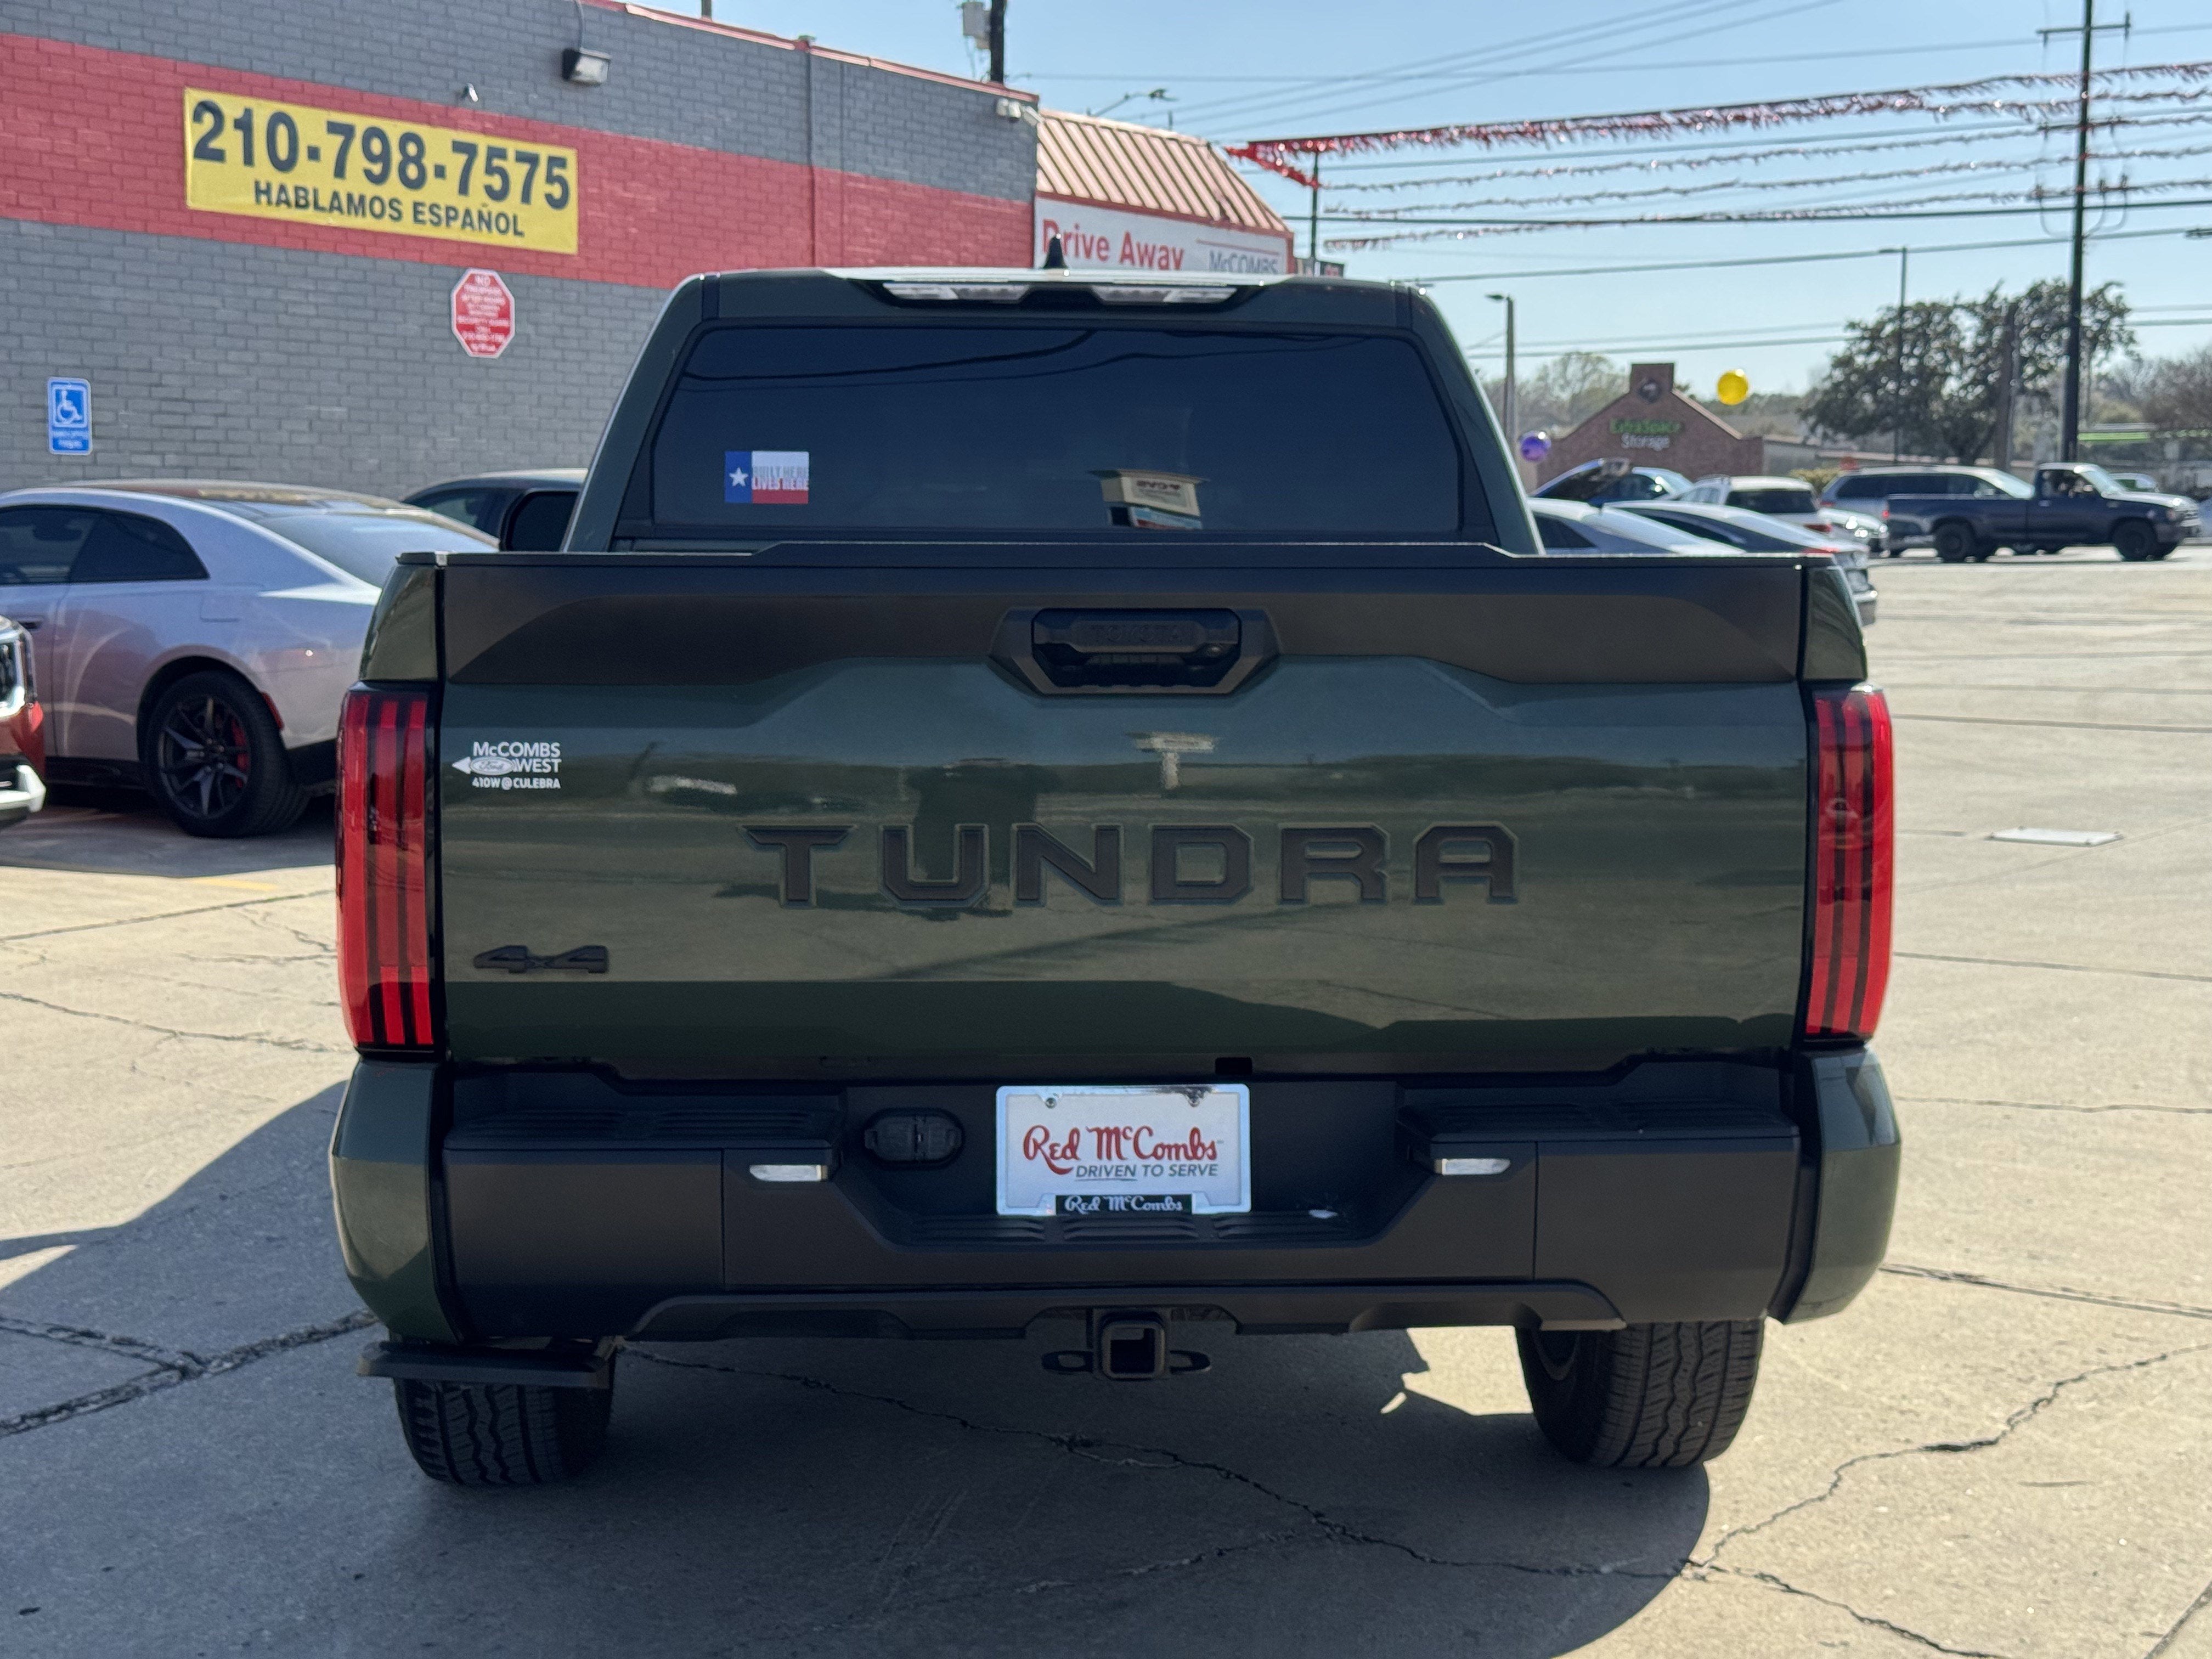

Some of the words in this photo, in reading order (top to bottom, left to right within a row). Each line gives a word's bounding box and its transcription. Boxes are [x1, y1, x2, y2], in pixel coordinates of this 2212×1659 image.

[192, 100, 570, 210] 210-798-7575
[254, 180, 402, 221] HABLAMOS
[414, 201, 524, 238] ESPAÑOL
[1043, 219, 1109, 262] Drive
[1119, 230, 1184, 270] Away
[473, 742, 561, 757] McCOMBS
[515, 758, 562, 773] WEST
[743, 824, 1519, 906] TUNDRA
[1023, 1125, 1081, 1175] Red
[1086, 1125, 1218, 1161] McCombs
[1076, 1164, 1137, 1178] DRIVEN
[1142, 1164, 1164, 1177] TO
[1169, 1163, 1218, 1177] SERVE
[1064, 1195, 1100, 1214] Red
[1104, 1195, 1183, 1211] McCombs
